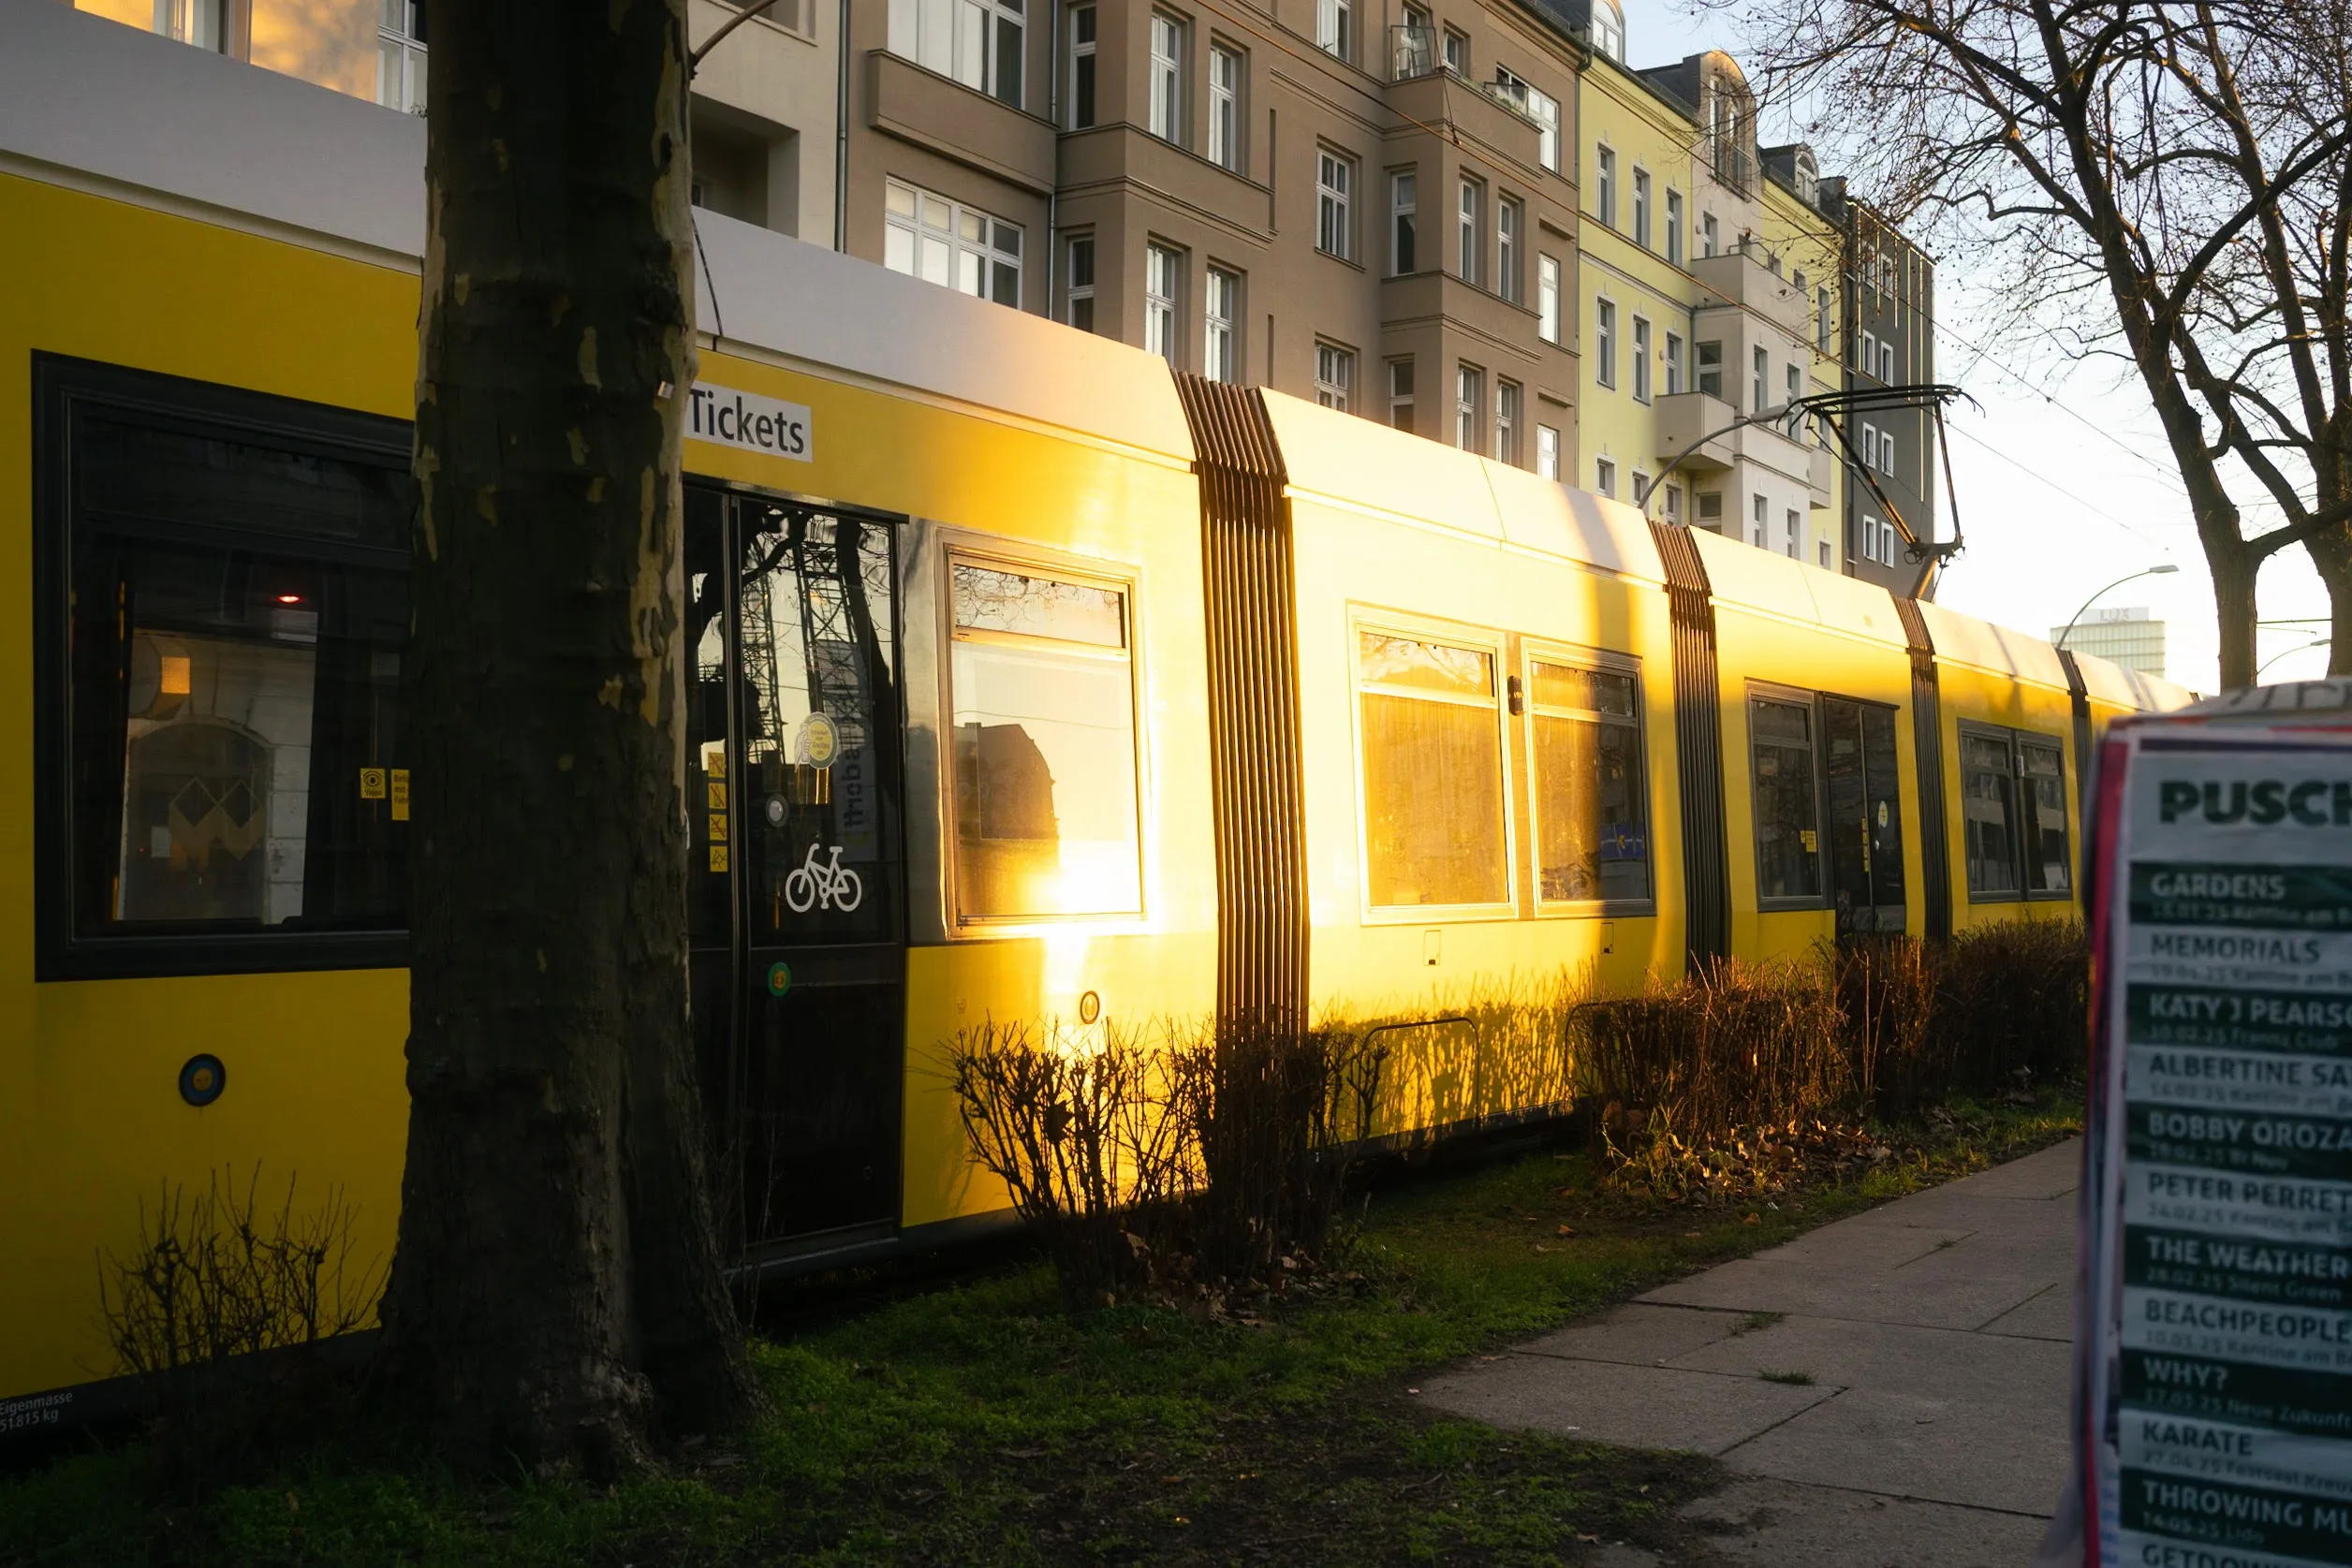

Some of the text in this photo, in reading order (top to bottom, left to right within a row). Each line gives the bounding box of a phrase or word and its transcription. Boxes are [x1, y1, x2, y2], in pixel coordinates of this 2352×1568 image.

[690, 388, 804, 454] Tickets
[2151, 871, 2286, 901] GARDENS
[2151, 932, 2321, 964] MEMORIALS
[2149, 992, 2223, 1020] KATY
[2229, 996, 2242, 1021] J
[2149, 1052, 2352, 1091] ALBERTINE SA
[2149, 1110, 2352, 1151] BOBBY OROZA
[2148, 1171, 2352, 1214] PETER PERRET
[2145, 1235, 2351, 1280] THE WEATHER
[2145, 1297, 2352, 1345] BEACHPEOPLE
[2143, 1356, 2228, 1391] WHY?
[0, 1392, 73, 1416] Eigenmasse
[43, 1408, 58, 1422] kg
[2143, 1419, 2254, 1457] KARATE
[2143, 1479, 2352, 1537] THROWING MU
